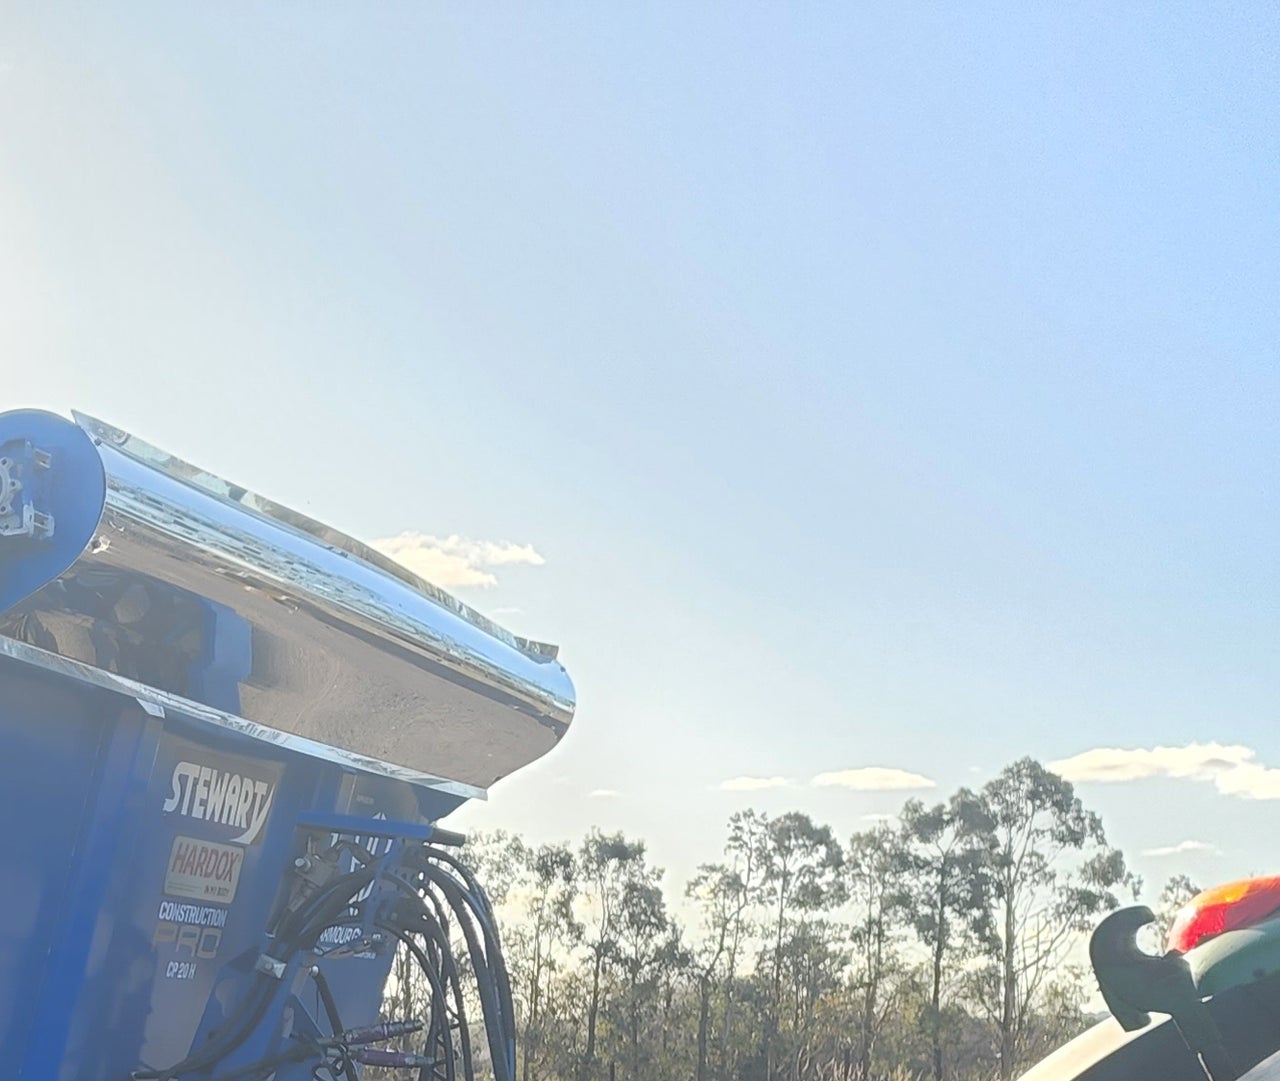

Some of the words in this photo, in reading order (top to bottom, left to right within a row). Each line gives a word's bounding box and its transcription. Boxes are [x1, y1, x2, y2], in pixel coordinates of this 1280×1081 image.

[163, 761, 275, 844] STEWART
[171, 842, 239, 882] HARDOX
[159, 901, 228, 928] CONSTRUCTION
[151, 920, 222, 959] PRO
[167, 961, 178, 978] CP
[177, 962, 189, 978] 20
[188, 963, 196, 979] H
